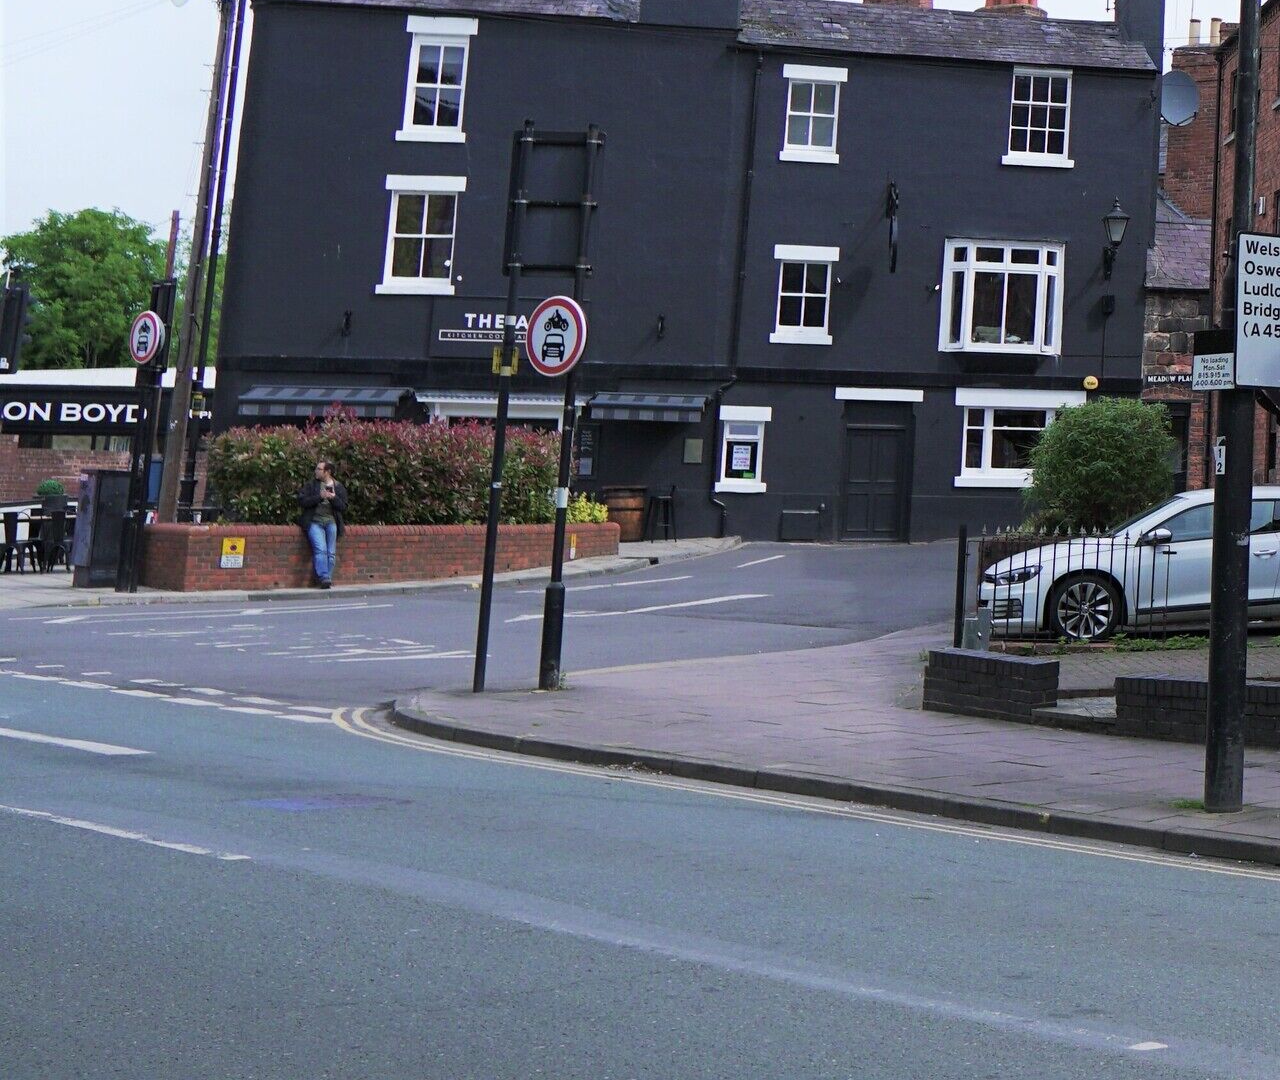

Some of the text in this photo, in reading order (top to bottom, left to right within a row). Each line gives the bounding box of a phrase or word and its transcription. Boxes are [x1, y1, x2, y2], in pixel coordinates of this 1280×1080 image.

[464, 313, 528, 329] THE A
[1, 401, 52, 421] ON
